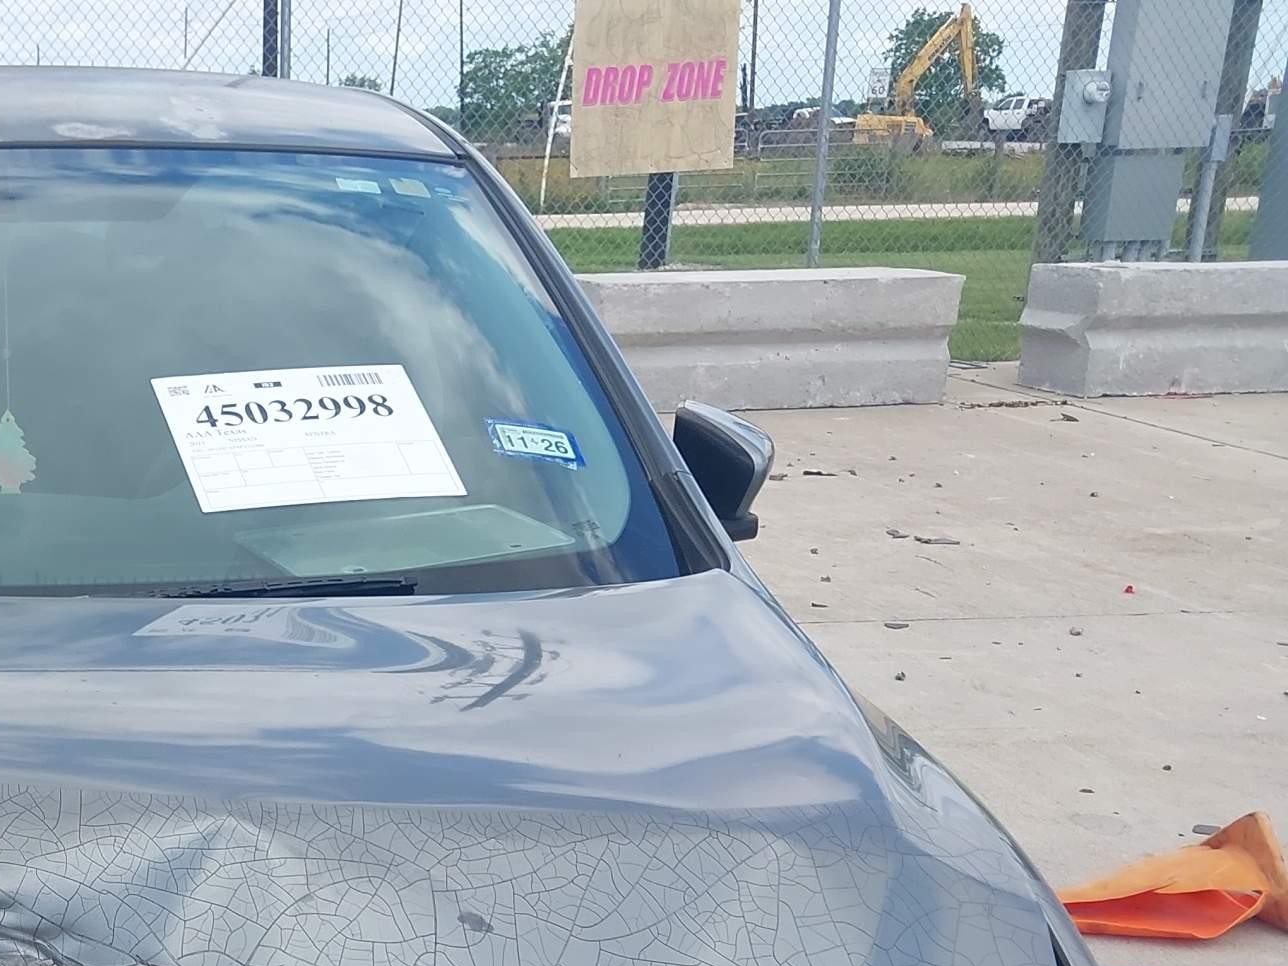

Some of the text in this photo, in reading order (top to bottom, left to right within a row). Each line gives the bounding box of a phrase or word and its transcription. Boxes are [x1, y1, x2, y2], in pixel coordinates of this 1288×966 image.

[582, 57, 727, 107] DROP ZONE
[195, 392, 395, 429] 45032998
[506, 434, 529, 449] 11
[541, 438, 569, 454] 26
